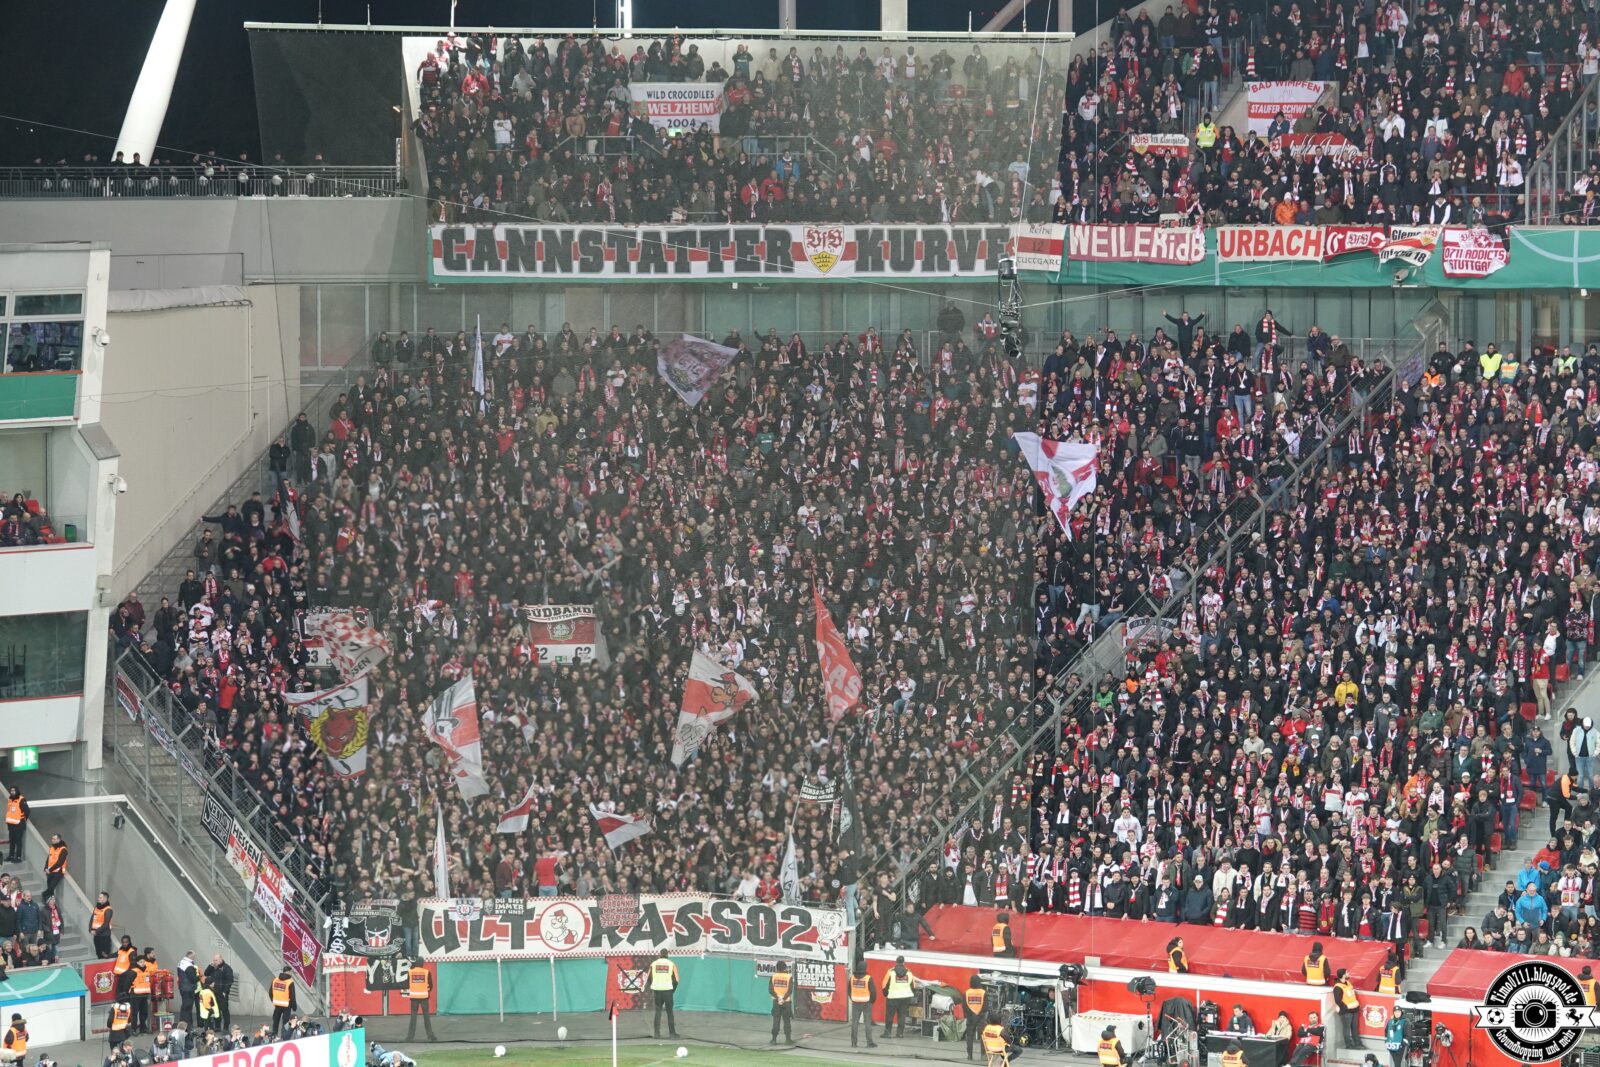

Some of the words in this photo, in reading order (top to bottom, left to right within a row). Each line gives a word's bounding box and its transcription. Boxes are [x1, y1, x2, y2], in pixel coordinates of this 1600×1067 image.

[1251, 80, 1273, 94] BAD
[1275, 80, 1321, 94] WIMPFEN
[646, 90, 666, 99] WILD
[667, 90, 715, 99] CROCODILES
[647, 102, 715, 115] WELZHEIM
[1250, 103, 1280, 114] STAUFER
[666, 118, 697, 128] 2004
[1219, 228, 1322, 258] URBACH
[440, 228, 795, 274] CANNSTATTER
[853, 228, 1011, 273] KURVE
[1413, 251, 1427, 263] 18
[1464, 248, 1505, 261] ADDICTS
[232, 822, 260, 864] HESSEN
[796, 963, 835, 974] ULTRAS
